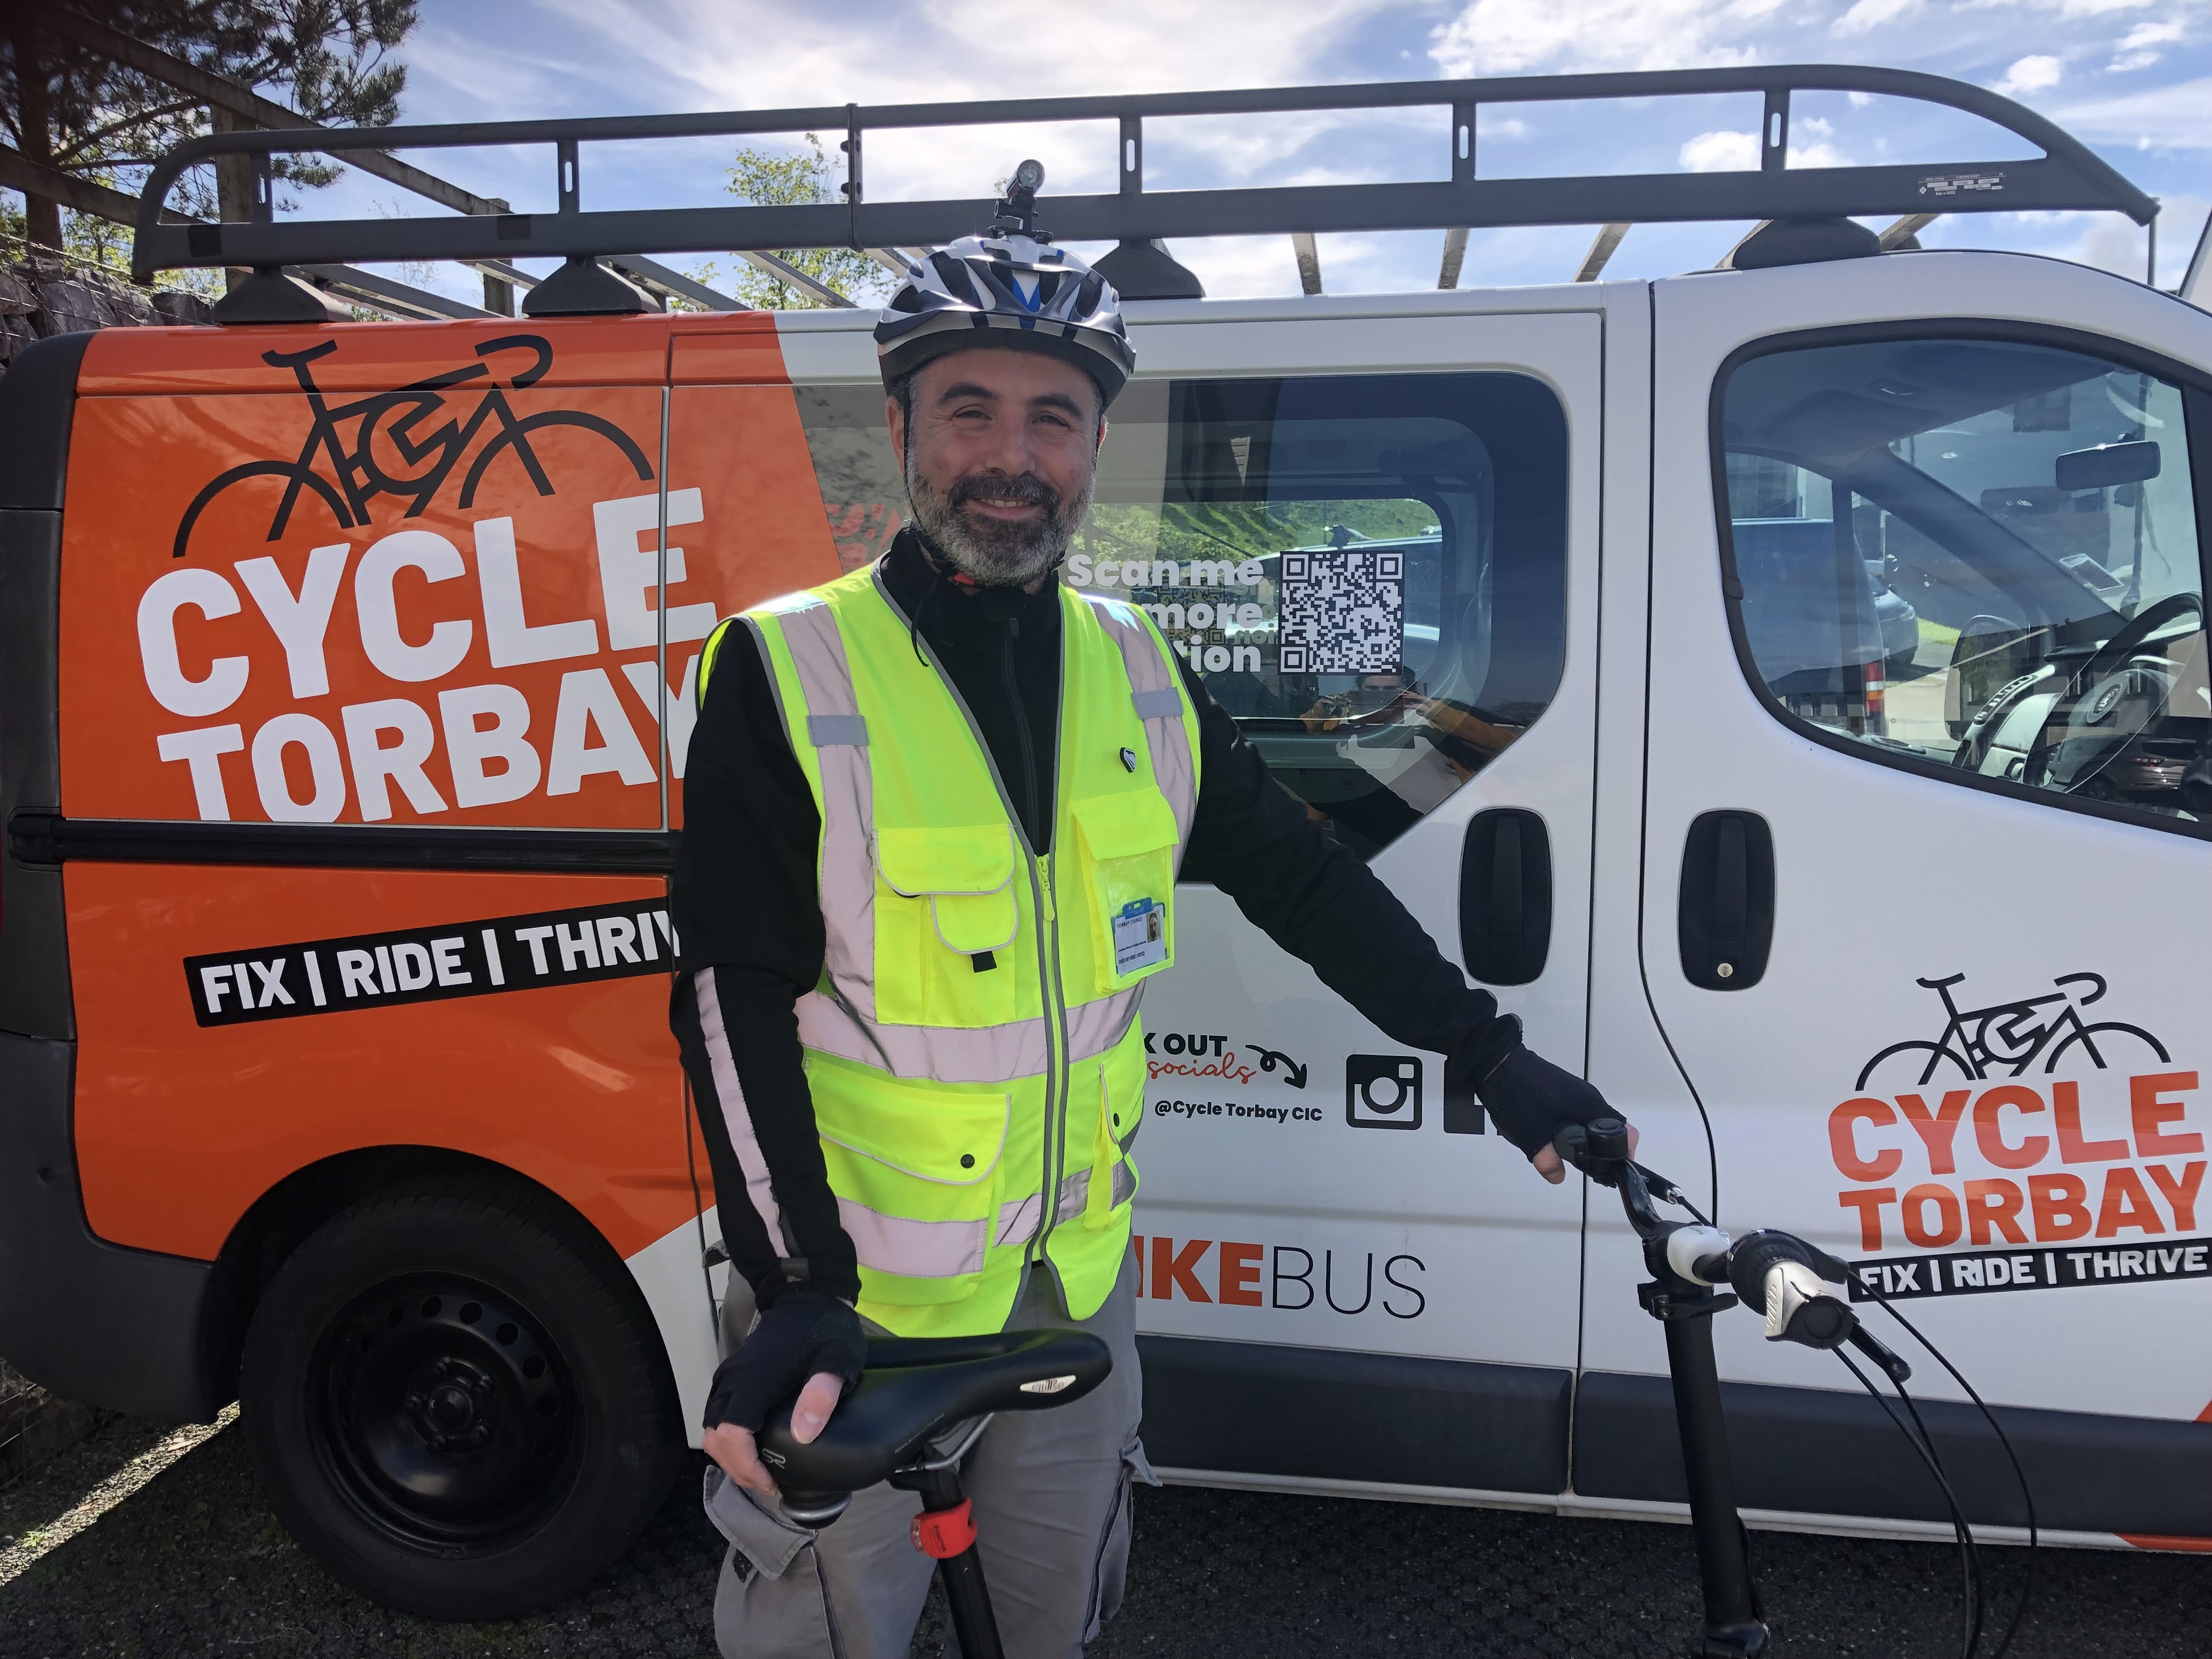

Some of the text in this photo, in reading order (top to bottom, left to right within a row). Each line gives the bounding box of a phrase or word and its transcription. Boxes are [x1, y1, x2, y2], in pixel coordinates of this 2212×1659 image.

[1068, 554, 1263, 586] Scan me
[137, 487, 718, 717] CYCLE
[157, 654, 700, 822] TORBAY
[200, 958, 295, 1013] FIX
[337, 936, 472, 997] RIDE
[1147, 1052, 1256, 1084] socials
[1164, 1033, 1227, 1057] OUT
[1155, 1100, 1323, 1124] @Cycle Torbay CIC
[1828, 1071, 2205, 1182] CYCLE
[1838, 1161, 2208, 1252] TORBAY
[1859, 1263, 1921, 1295] FIX
[1951, 1255, 2036, 1288] RIDE
[2067, 1246, 2208, 1280] THRIVE
